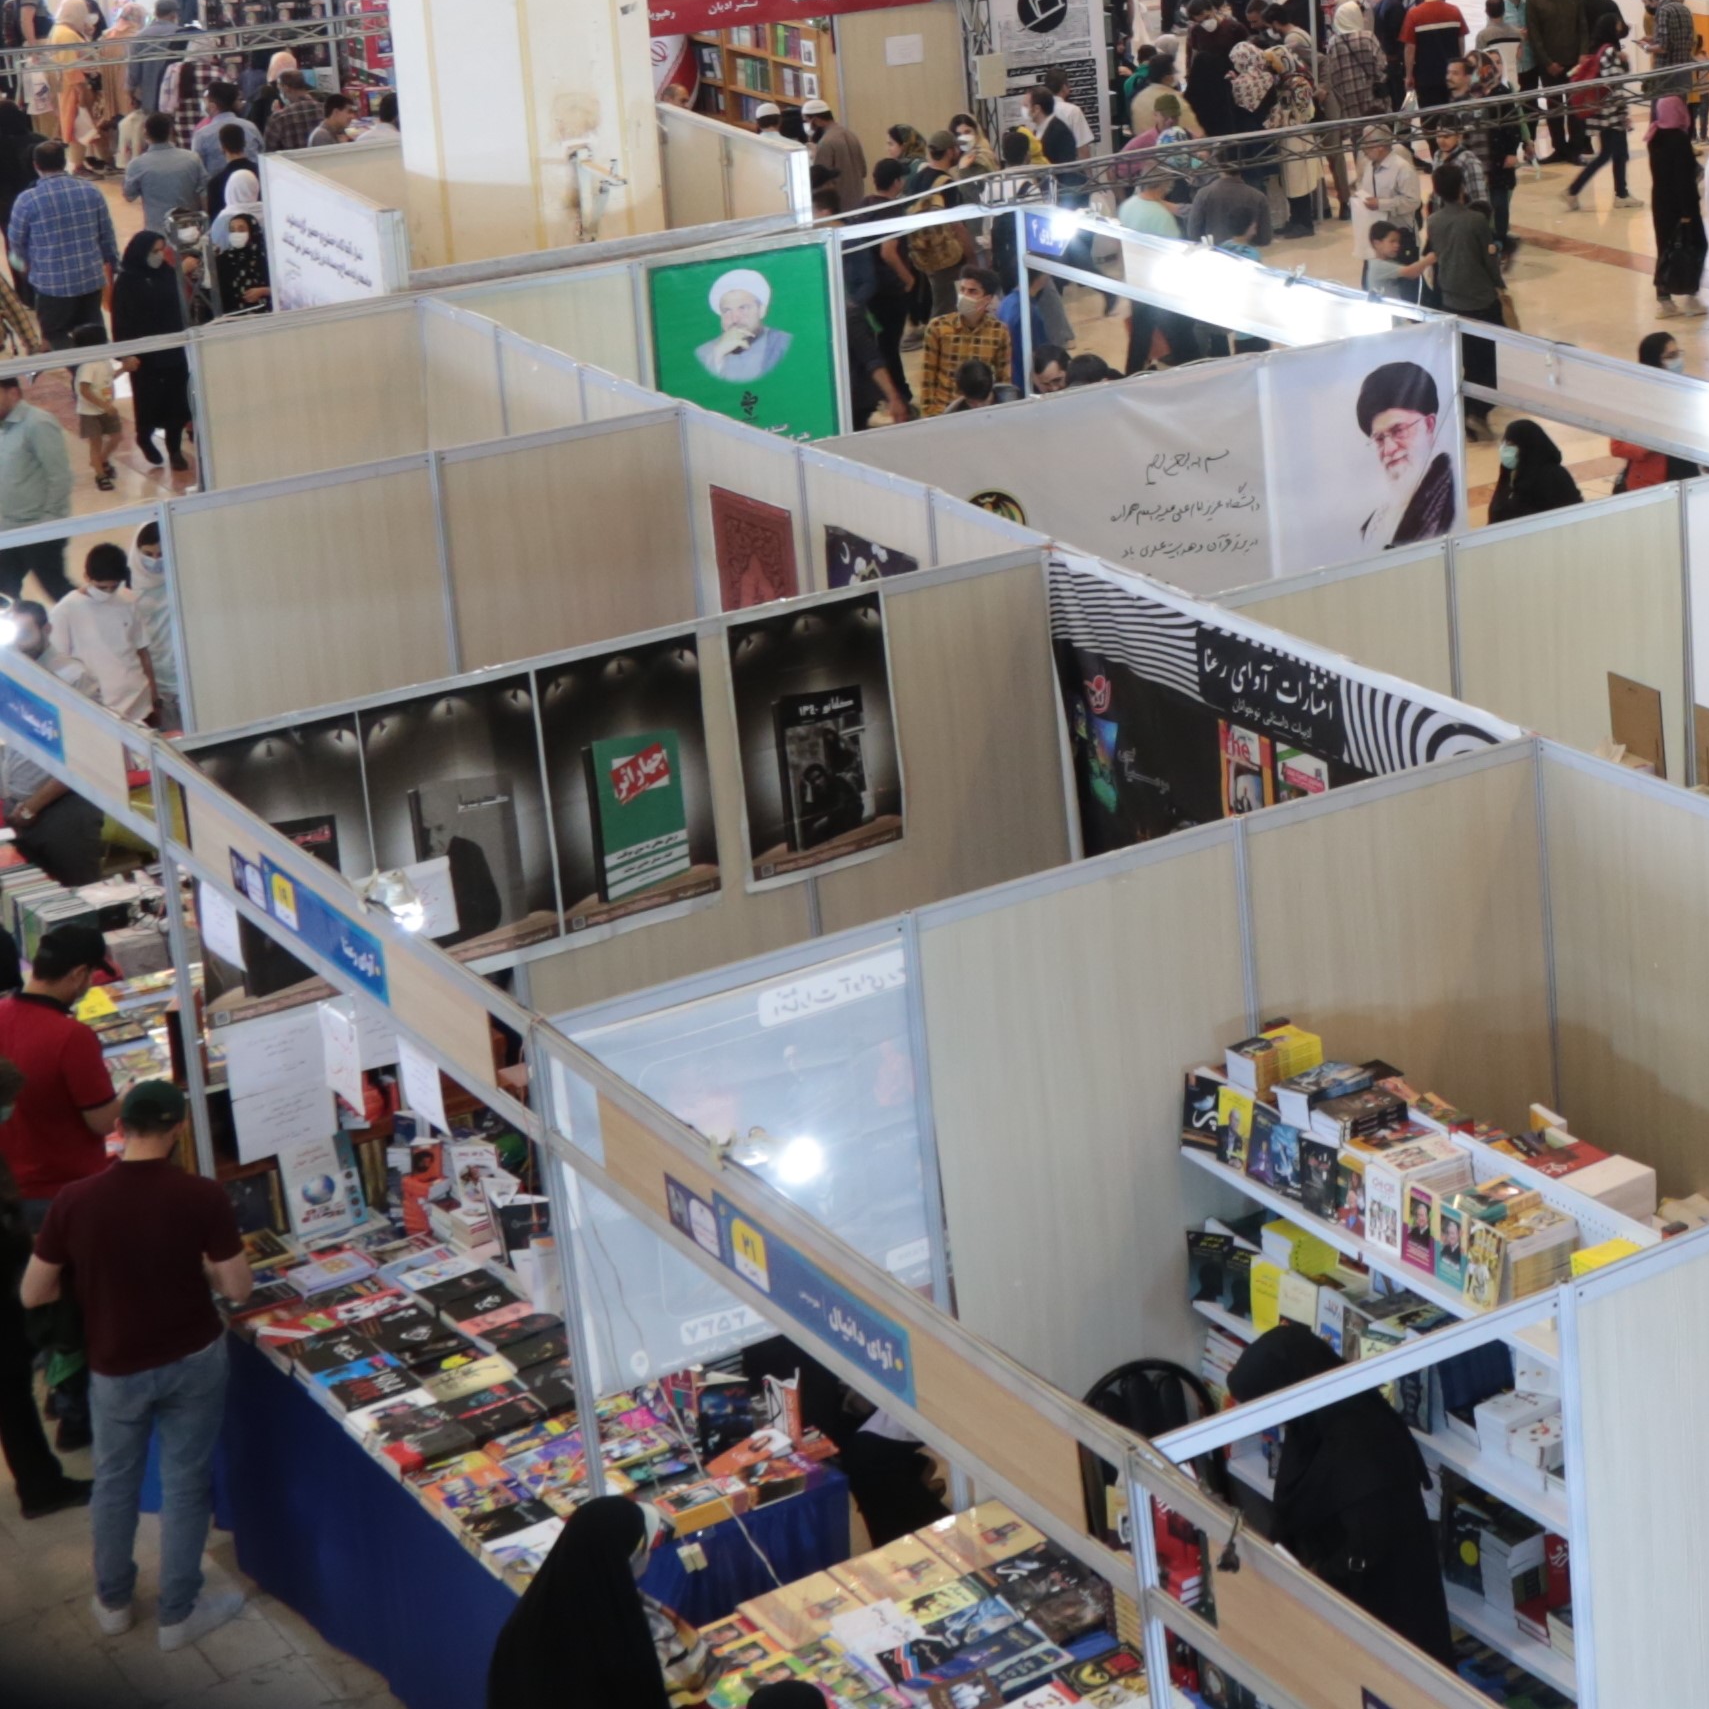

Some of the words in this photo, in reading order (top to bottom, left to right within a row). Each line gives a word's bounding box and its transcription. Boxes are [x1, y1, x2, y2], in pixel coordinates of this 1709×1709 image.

[1202, 647, 1228, 679] رعنا
[1230, 660, 1274, 693] آوای
[828, 1306, 867, 1347] دانیال
